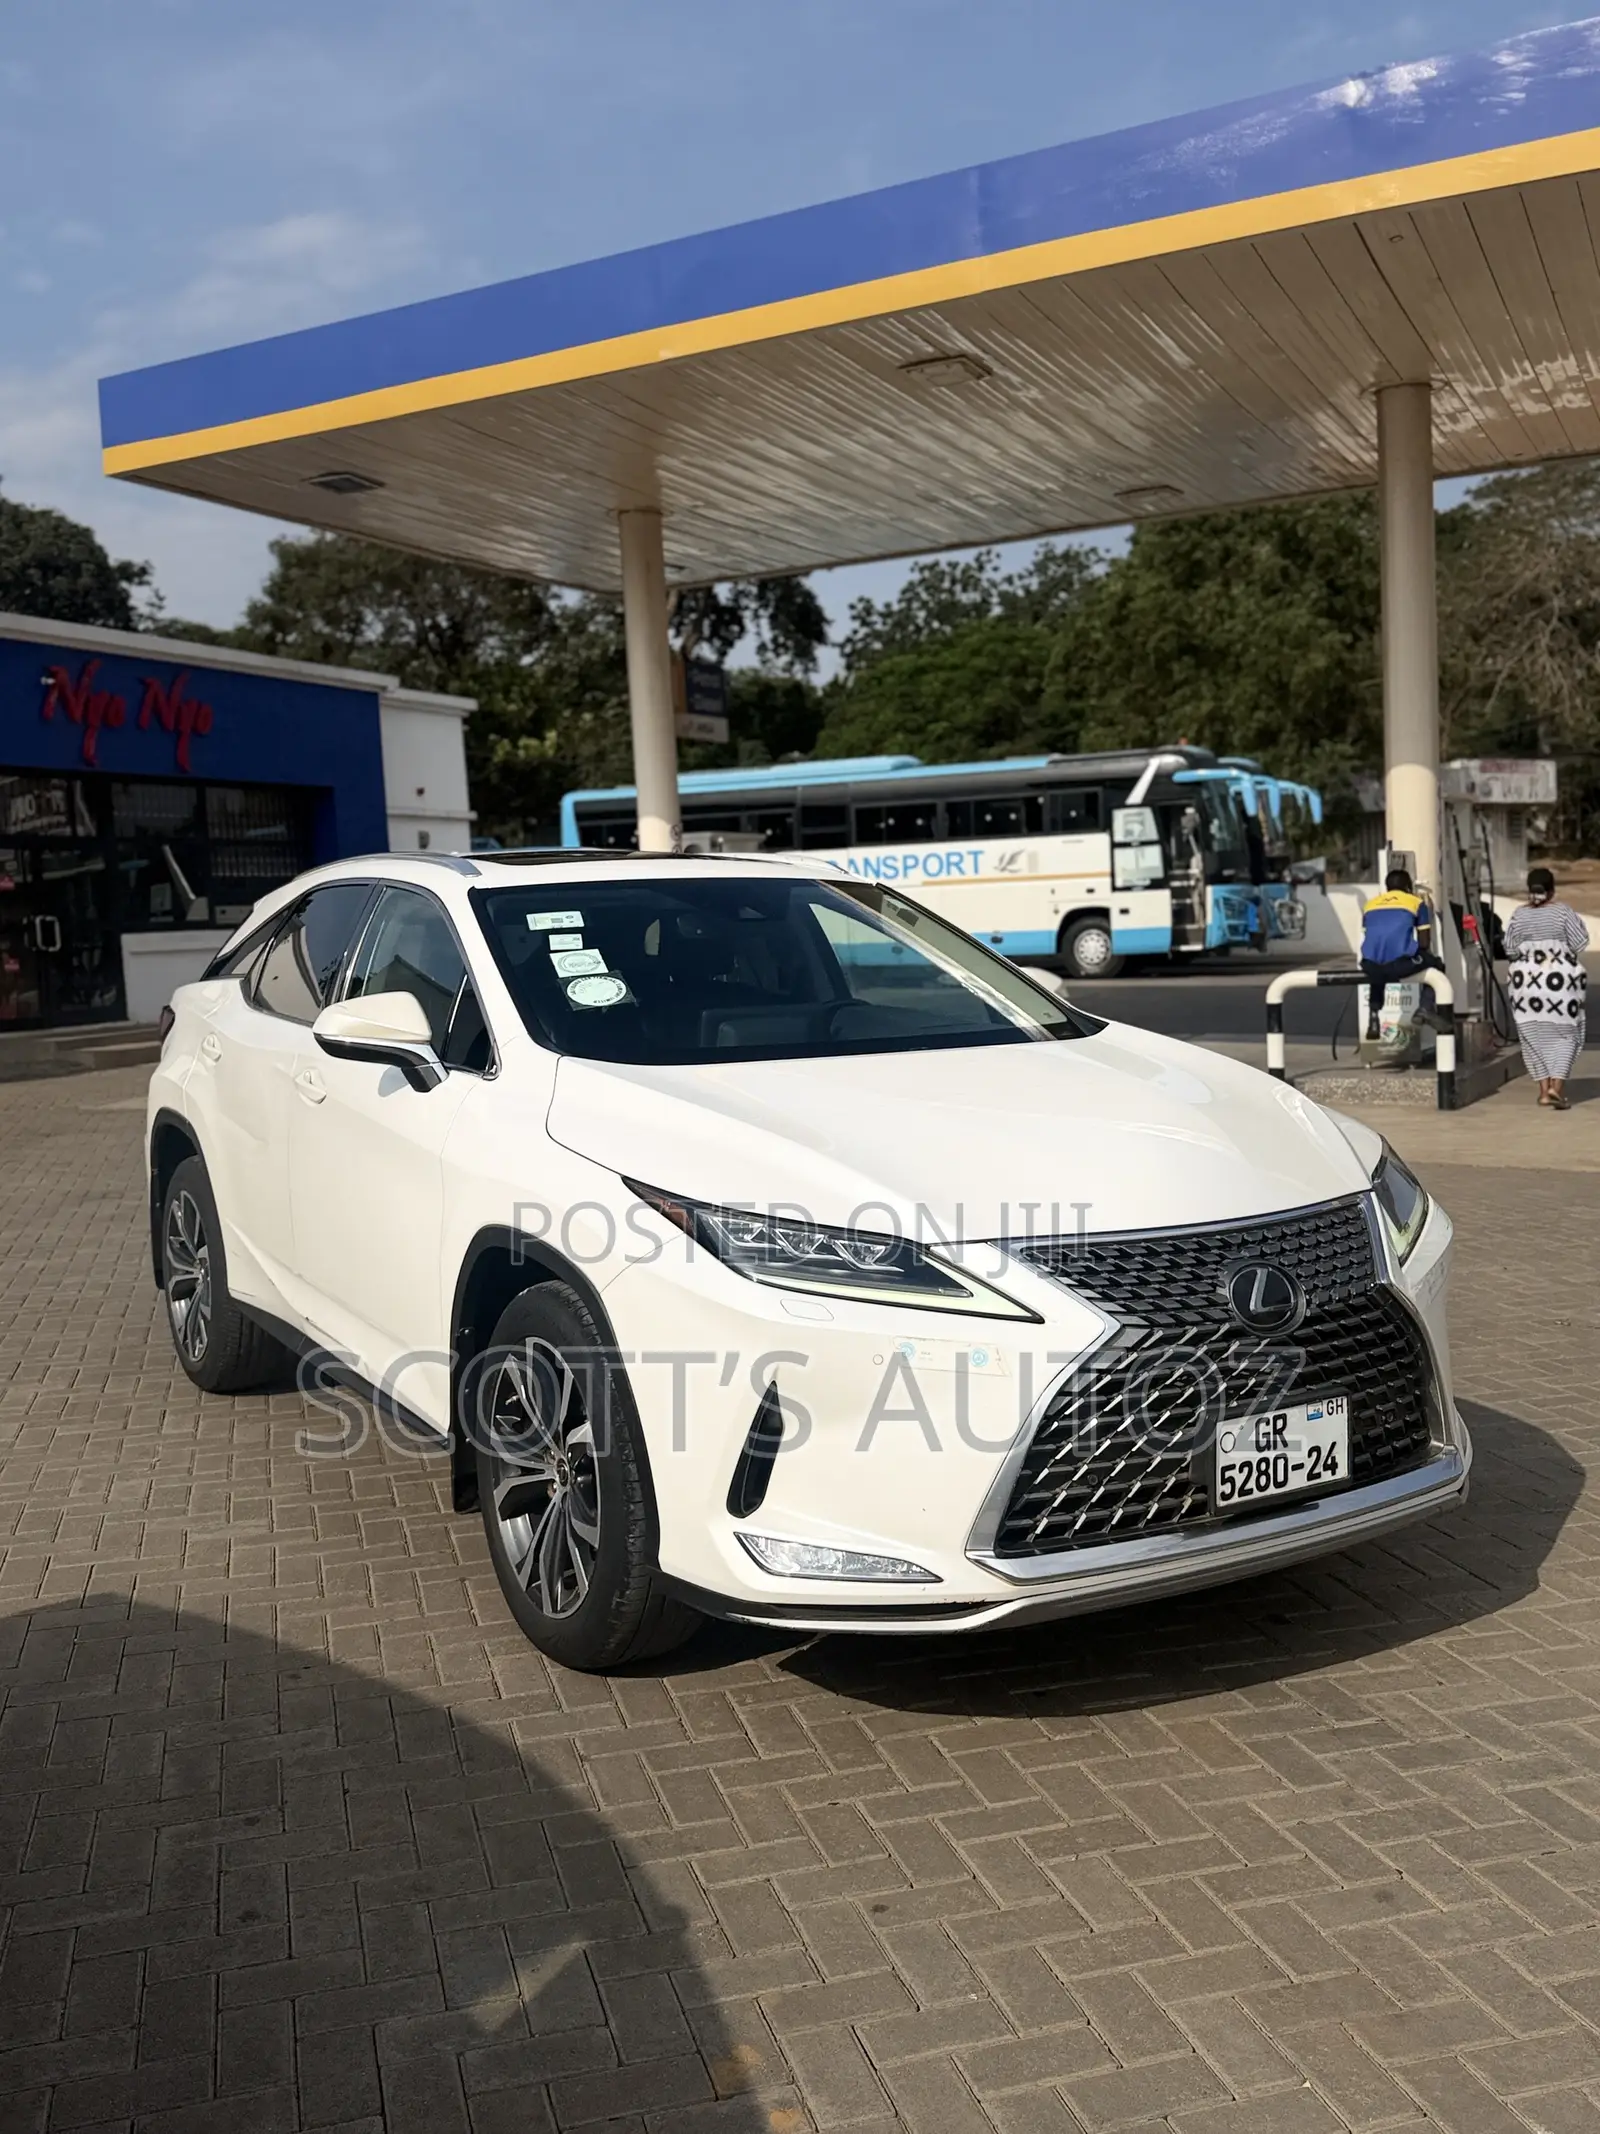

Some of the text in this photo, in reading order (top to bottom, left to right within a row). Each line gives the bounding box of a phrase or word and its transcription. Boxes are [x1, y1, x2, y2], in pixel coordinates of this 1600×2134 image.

[828, 849, 984, 880] ANSPORT
[1326, 1398, 1345, 1416] GH
[1255, 1412, 1289, 1453] GR
[1219, 1441, 1339, 1501] 5280-24
